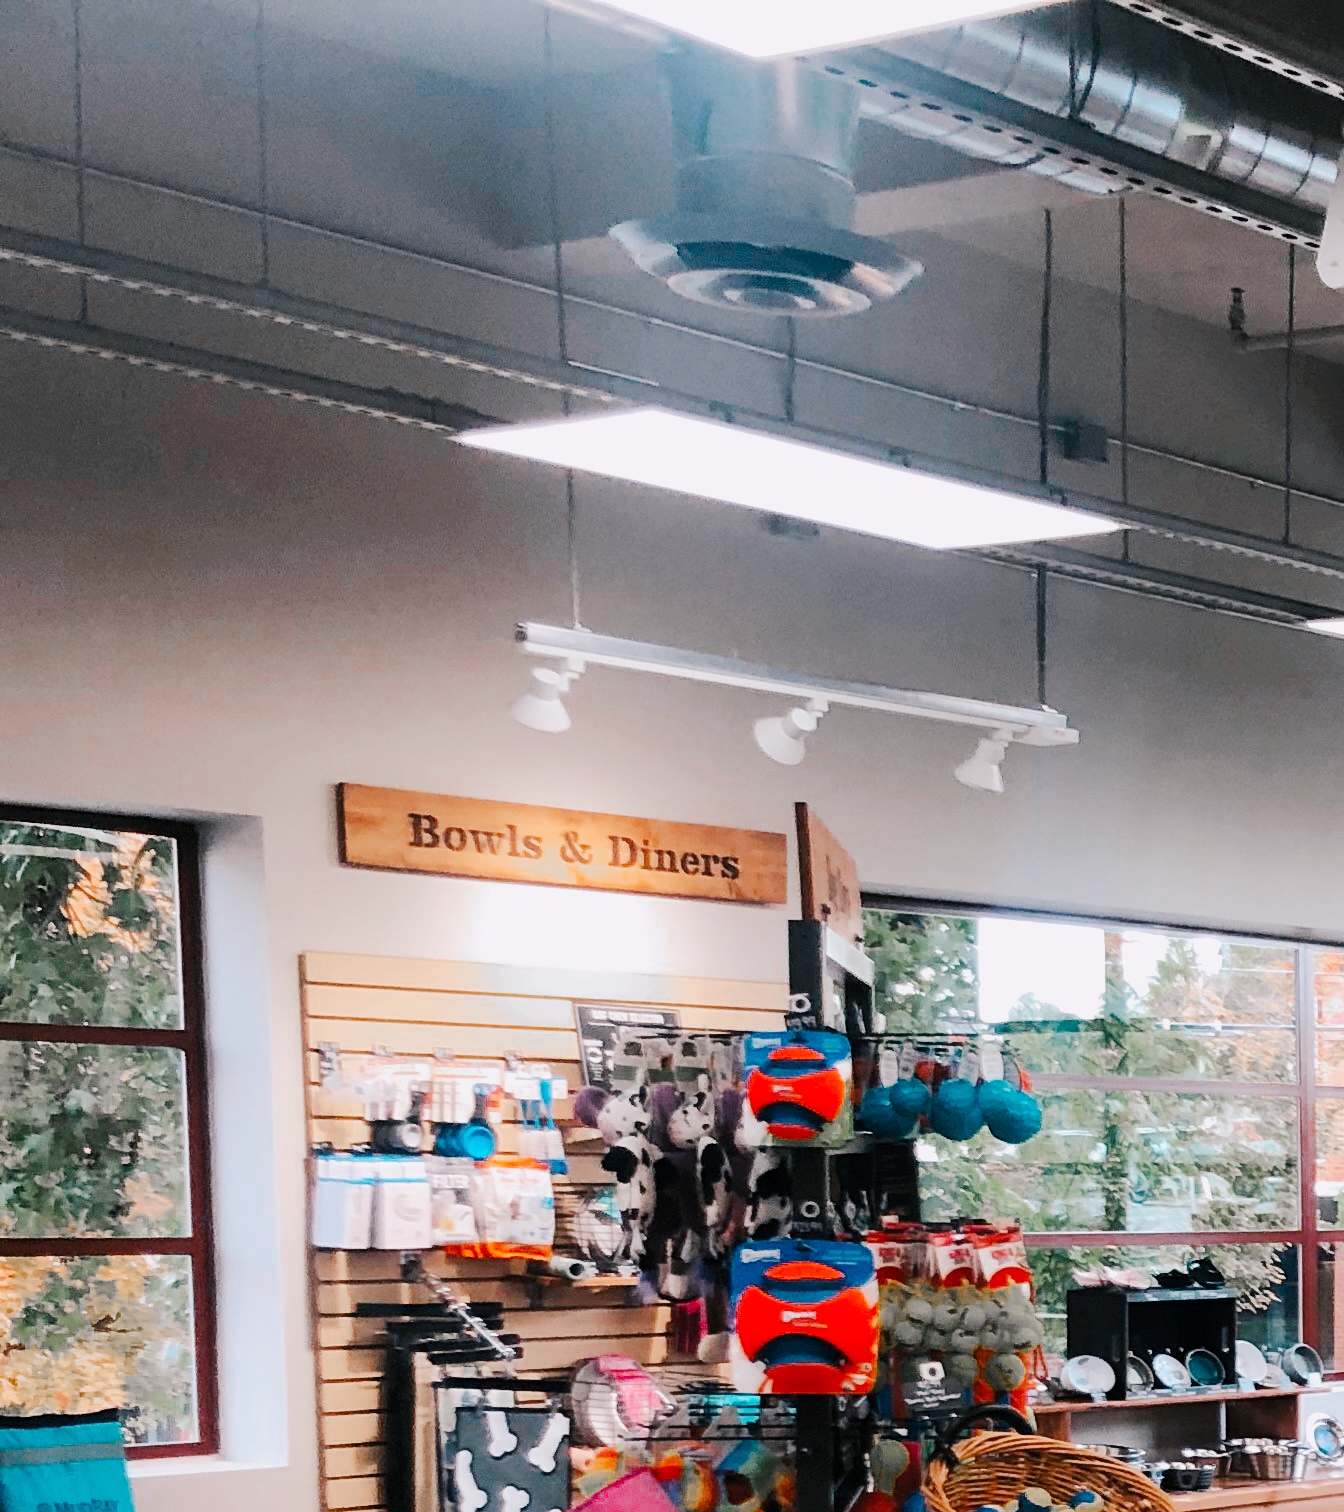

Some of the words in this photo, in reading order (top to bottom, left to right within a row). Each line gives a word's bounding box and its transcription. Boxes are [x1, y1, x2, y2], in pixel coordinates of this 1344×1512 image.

[408, 812, 543, 860] Bowls
[560, 831, 593, 865] &
[608, 835, 741, 881] Diners
